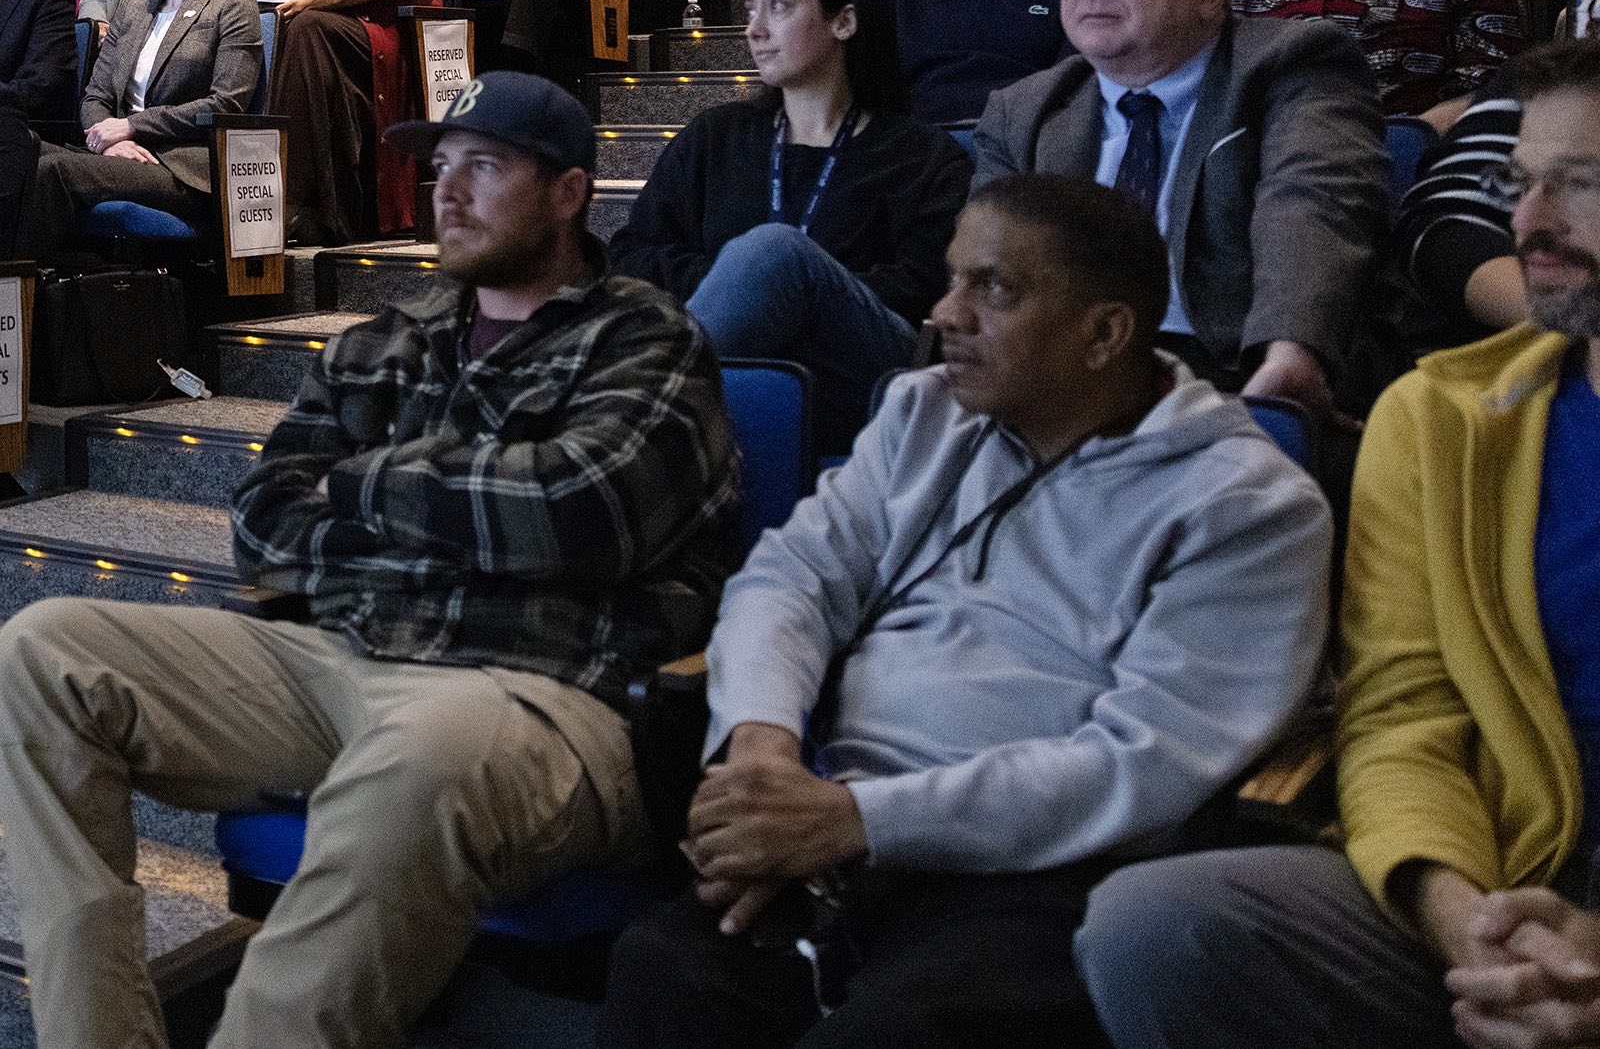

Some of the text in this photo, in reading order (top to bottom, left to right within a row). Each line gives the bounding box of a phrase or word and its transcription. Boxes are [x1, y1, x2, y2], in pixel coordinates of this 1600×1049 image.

[428, 48, 464, 62] RESERVED
[434, 68, 463, 82] SPECIAL
[451, 78, 485, 117] B
[231, 161, 276, 176] RESERVED
[237, 184, 274, 199] SPECIAL
[239, 208, 273, 223] GUESTS
